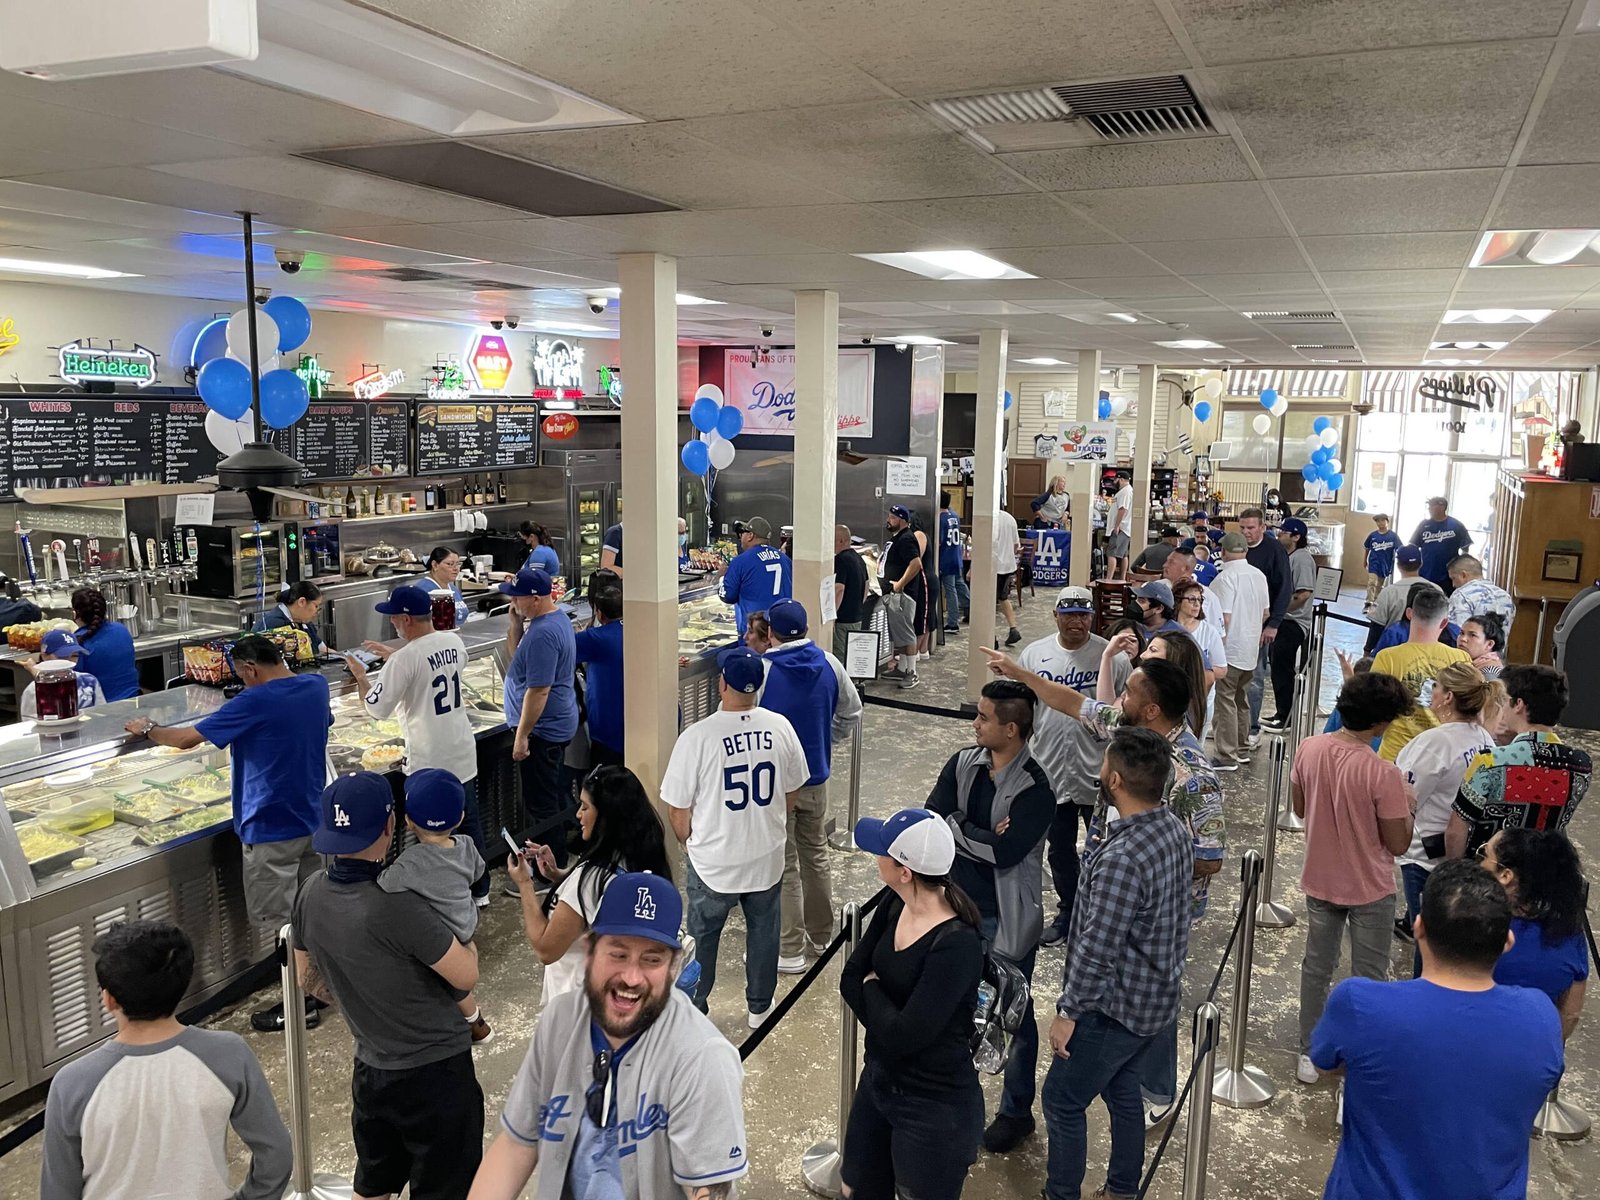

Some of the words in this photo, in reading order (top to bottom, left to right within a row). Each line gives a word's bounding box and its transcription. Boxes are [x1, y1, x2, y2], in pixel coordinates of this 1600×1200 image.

[64, 354, 150, 377] Heineken
[29, 402, 72, 412] WHITES
[114, 403, 140, 413] REDS
[946, 528, 960, 546] 50
[1034, 529, 1063, 566] LA
[1371, 541, 1394, 552] Dodgers
[1423, 530, 1456, 543] Dodgers
[765, 563, 782, 596] 7
[1033, 568, 1068, 580] ODGERS
[62, 633, 74, 644] LA
[427, 648, 458, 671] MAYOR
[1036, 666, 1099, 693] Dodger
[432, 670, 461, 715] 21
[723, 731, 773, 757] BETTS
[724, 761, 776, 811] 50
[334, 804, 351, 827] LA
[634, 887, 657, 920] LA
